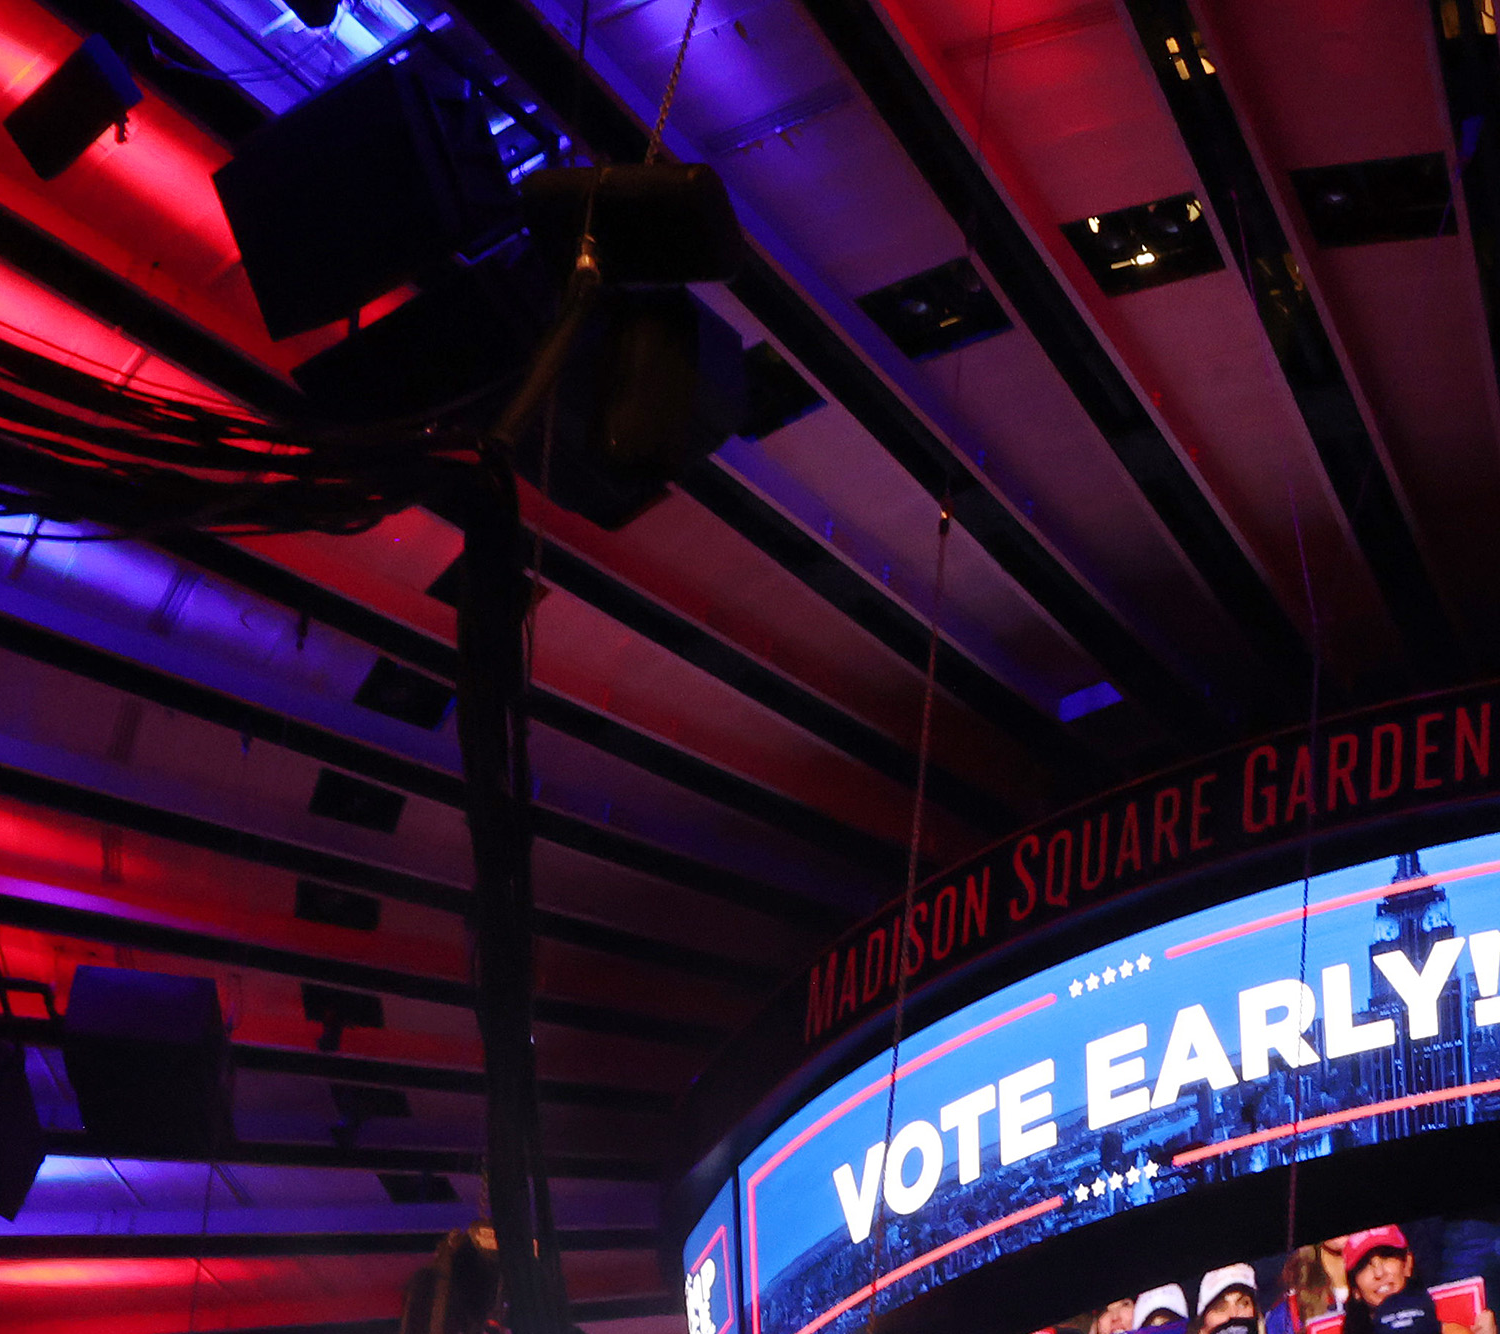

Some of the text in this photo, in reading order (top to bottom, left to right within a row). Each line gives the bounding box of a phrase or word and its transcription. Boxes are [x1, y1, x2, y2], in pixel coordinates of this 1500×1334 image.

[805, 701, 1491, 1044] MADISON SQUARE GARDEN
[831, 1058, 1057, 1245] VOTE
